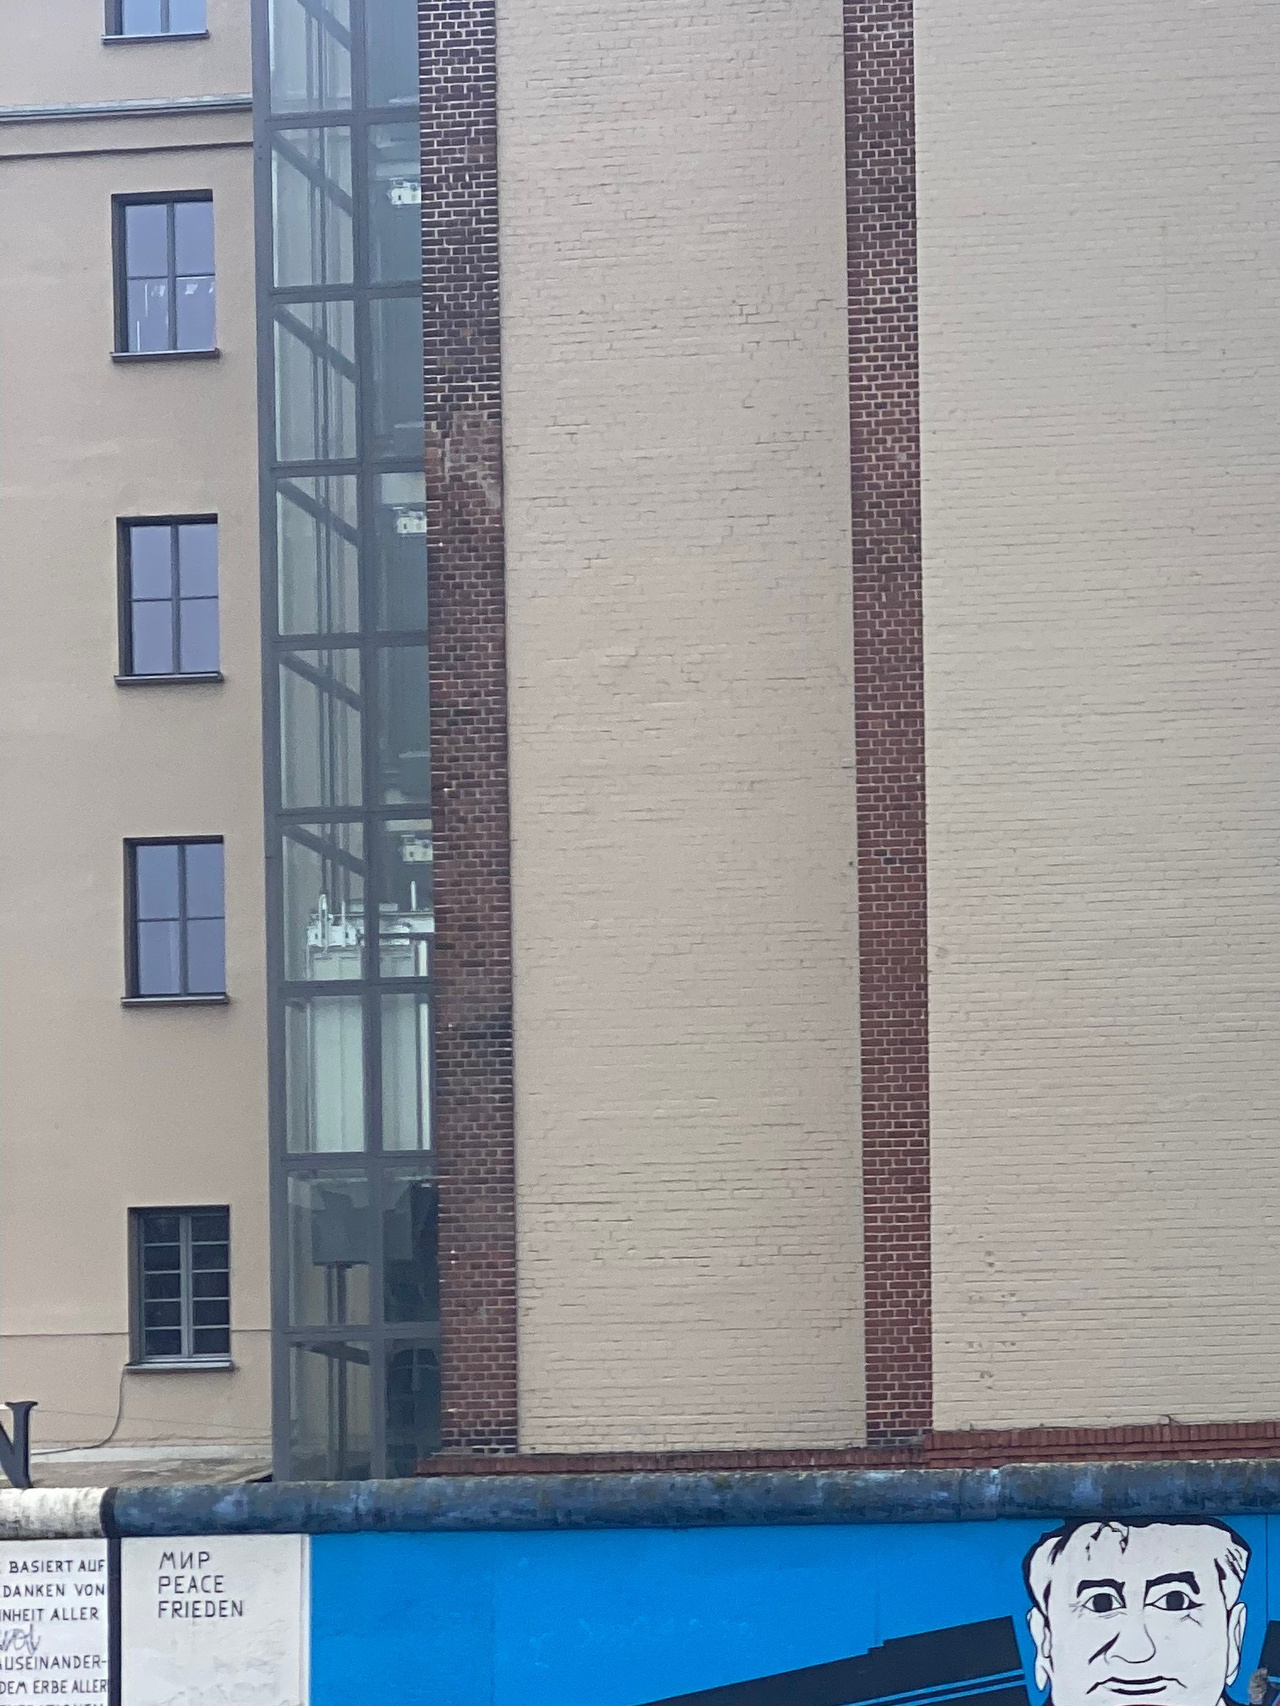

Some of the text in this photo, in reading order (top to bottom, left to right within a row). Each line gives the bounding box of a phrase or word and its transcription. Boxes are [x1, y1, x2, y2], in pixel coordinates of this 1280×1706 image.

[9, 1559, 105, 1574] BASIERT AUF
[3, 1583, 105, 1598] DANKEN VON
[158, 1575, 225, 1594] PEACE
[0, 1606, 100, 1622] NHEIT ALLER
[158, 1600, 244, 1619] FRIEDEN
[0, 1679, 107, 1695] DEM ERBE ALLER
